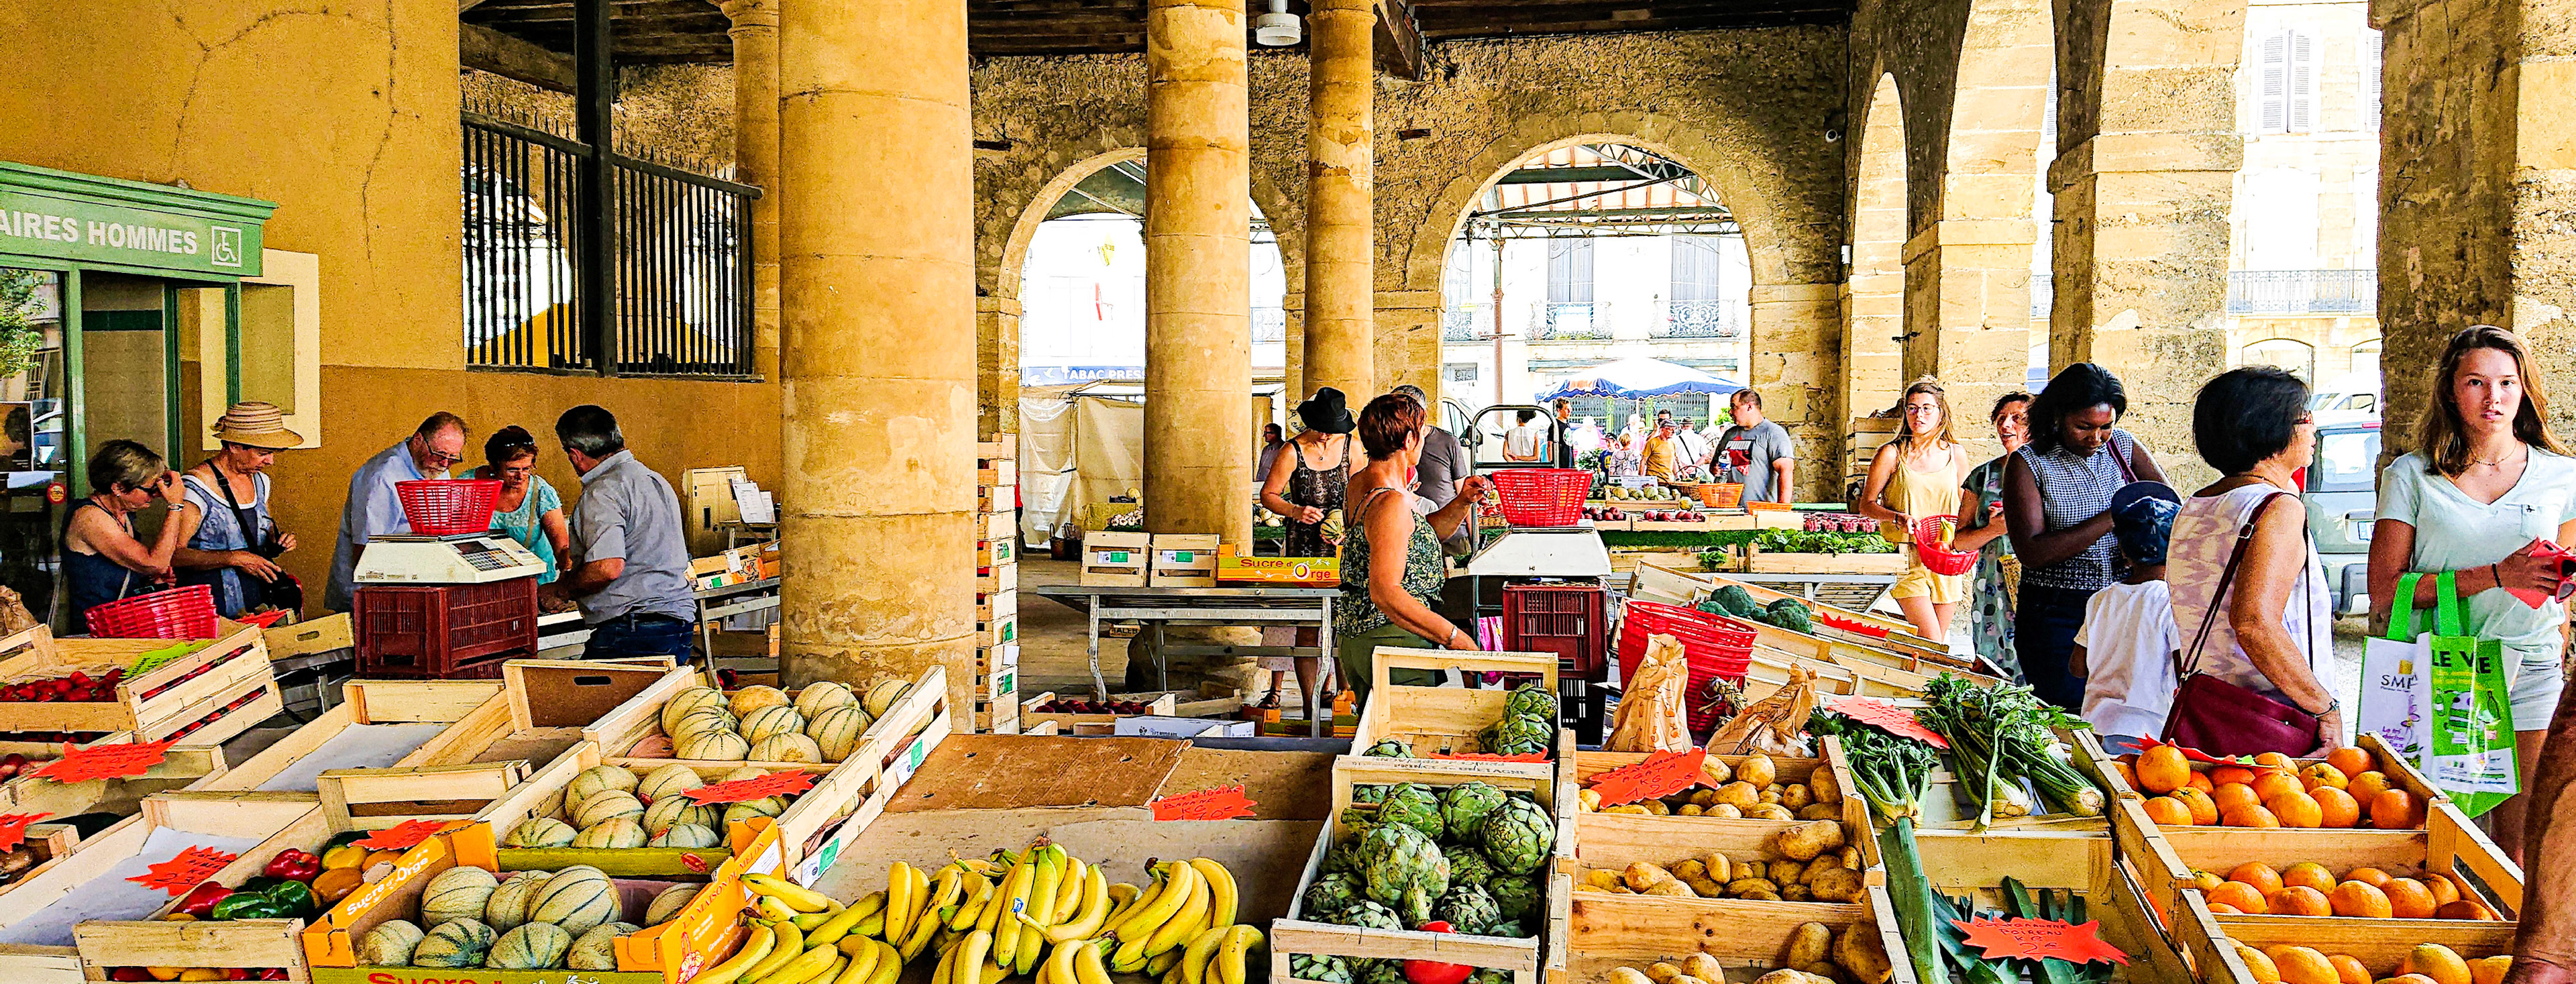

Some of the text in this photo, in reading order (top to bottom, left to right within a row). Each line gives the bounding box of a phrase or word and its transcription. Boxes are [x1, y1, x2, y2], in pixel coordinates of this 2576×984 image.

[87, 220, 198, 254] HOMMES
[1061, 369, 1106, 380] TABAC
[1240, 559, 1285, 567] Sucre
[1295, 564, 1332, 580] Orge
[2432, 649, 2451, 667] LE
[1622, 763, 1676, 783] AGATA
[1640, 775, 1662, 785] KG
[1164, 798, 1217, 809] BANANE
[1181, 805, 1206, 814] KG
[347, 883, 385, 916] Sucre
[396, 857, 429, 881] Orge
[696, 881, 727, 914] MAISON
[739, 842, 765, 869] MELON
